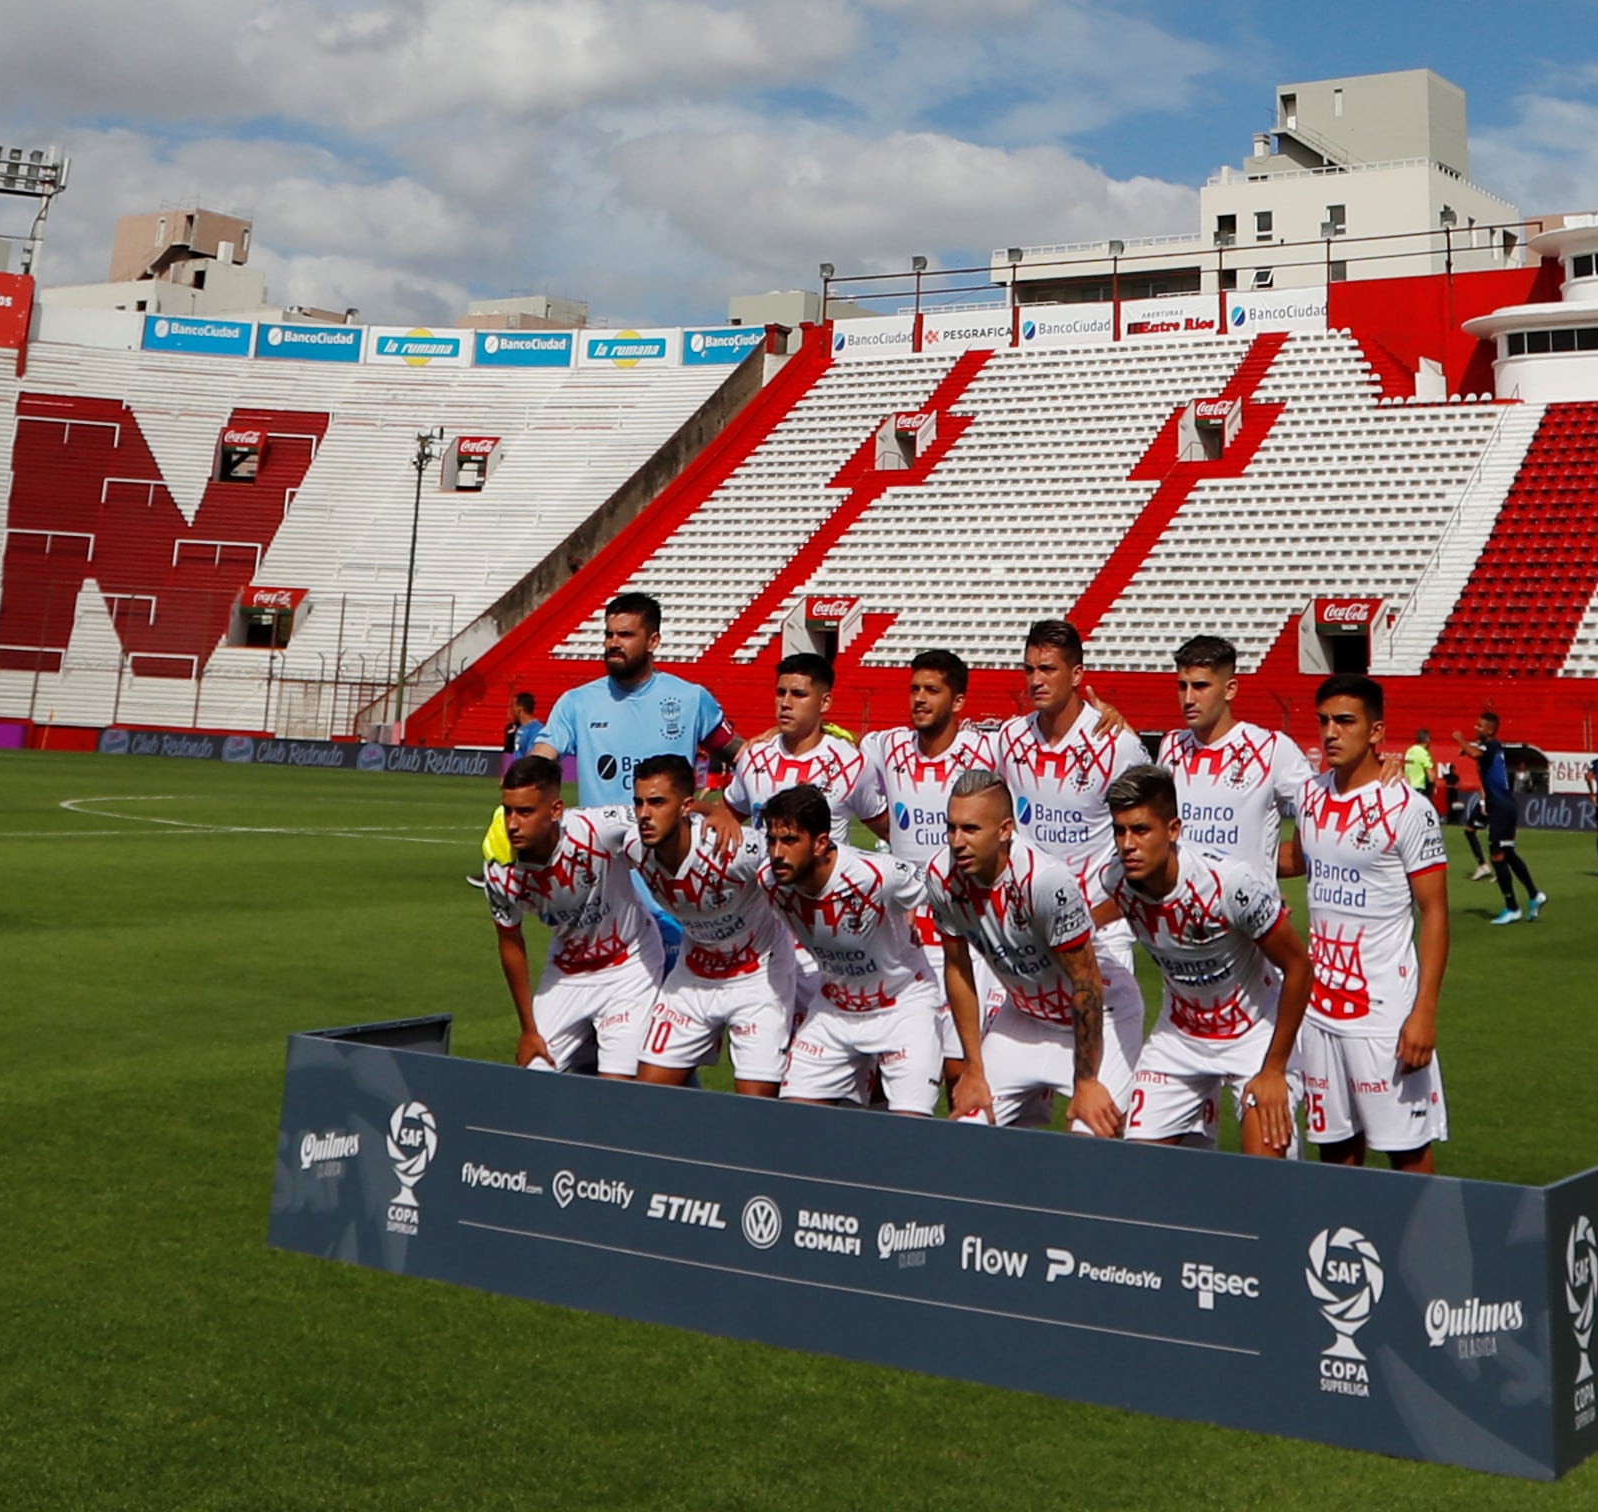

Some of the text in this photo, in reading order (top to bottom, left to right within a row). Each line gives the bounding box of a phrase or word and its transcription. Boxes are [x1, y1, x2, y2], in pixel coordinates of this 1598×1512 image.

[1249, 303, 1328, 321] BancoCiudad
[171, 320, 240, 338] BancoCiudad
[284, 331, 354, 345] BancoCiudad
[943, 326, 1013, 341] PESGRAFICA
[1039, 318, 1111, 335] BancoCiudad
[401, 342, 454, 356] rumana
[500, 337, 567, 351] BancoCiudad
[610, 343, 660, 356] rumana
[705, 334, 764, 349] BancoCiuda
[131, 734, 159, 756] Club
[160, 735, 213, 759] Redondo
[257, 741, 285, 763] Club
[287, 742, 344, 767] Redondo
[387, 746, 421, 772] Club
[423, 748, 490, 776] Redondo
[913, 808, 949, 825] Ban
[1035, 803, 1082, 823] Banco
[1182, 802, 1234, 821] Banco
[1524, 797, 1572, 827] Club
[1035, 824, 1090, 844] Ciudad
[1314, 859, 1360, 883] Banco
[1313, 882, 1367, 908] Ciudad
[813, 946, 866, 962] Banco
[643, 1017, 673, 1055] 10
[399, 1128, 423, 1148] SAF
[300, 1132, 359, 1169] Quilmes
[576, 1179, 634, 1209] cabify
[387, 1206, 418, 1224] COPA
[647, 1193, 726, 1229] STIHL
[798, 1209, 859, 1234] BANCO
[794, 1230, 861, 1256] COMAFI
[877, 1221, 945, 1259] Quilmes
[961, 1235, 1028, 1278] flow
[1078, 1261, 1162, 1290] PedidosYa
[1326, 1260, 1362, 1285] SAF
[1425, 1297, 1523, 1347] Quilmes
[1320, 1359, 1369, 1383] COPA
[1320, 1378, 1369, 1398] SUPERLIGA
[1574, 1382, 1595, 1412] COPA
